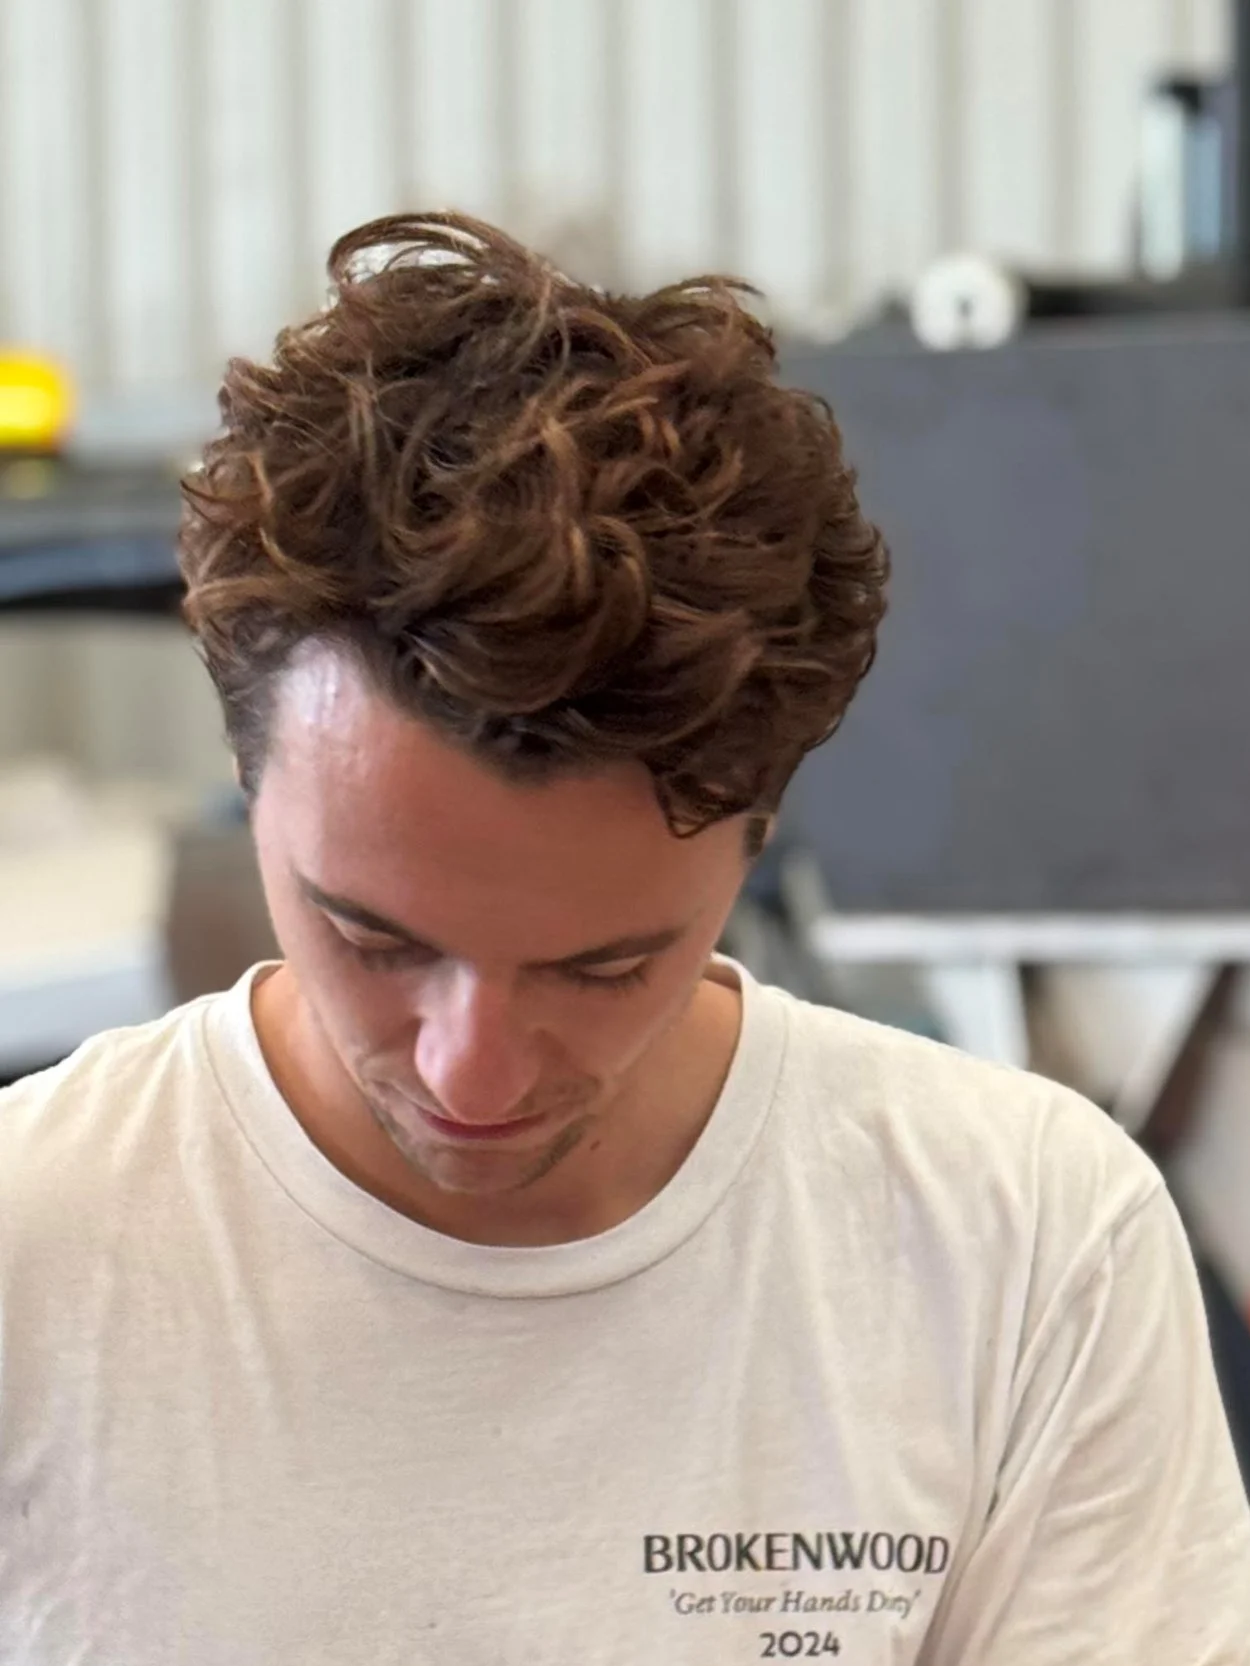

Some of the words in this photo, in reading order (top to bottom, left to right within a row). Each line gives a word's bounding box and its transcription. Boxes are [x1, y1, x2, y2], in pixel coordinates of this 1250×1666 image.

[643, 1532, 950, 1574] BROKENWOOD
[719, 1590, 777, 1614] Your
[780, 1590, 861, 1613] Hands
[759, 1631, 840, 1658] 2024
